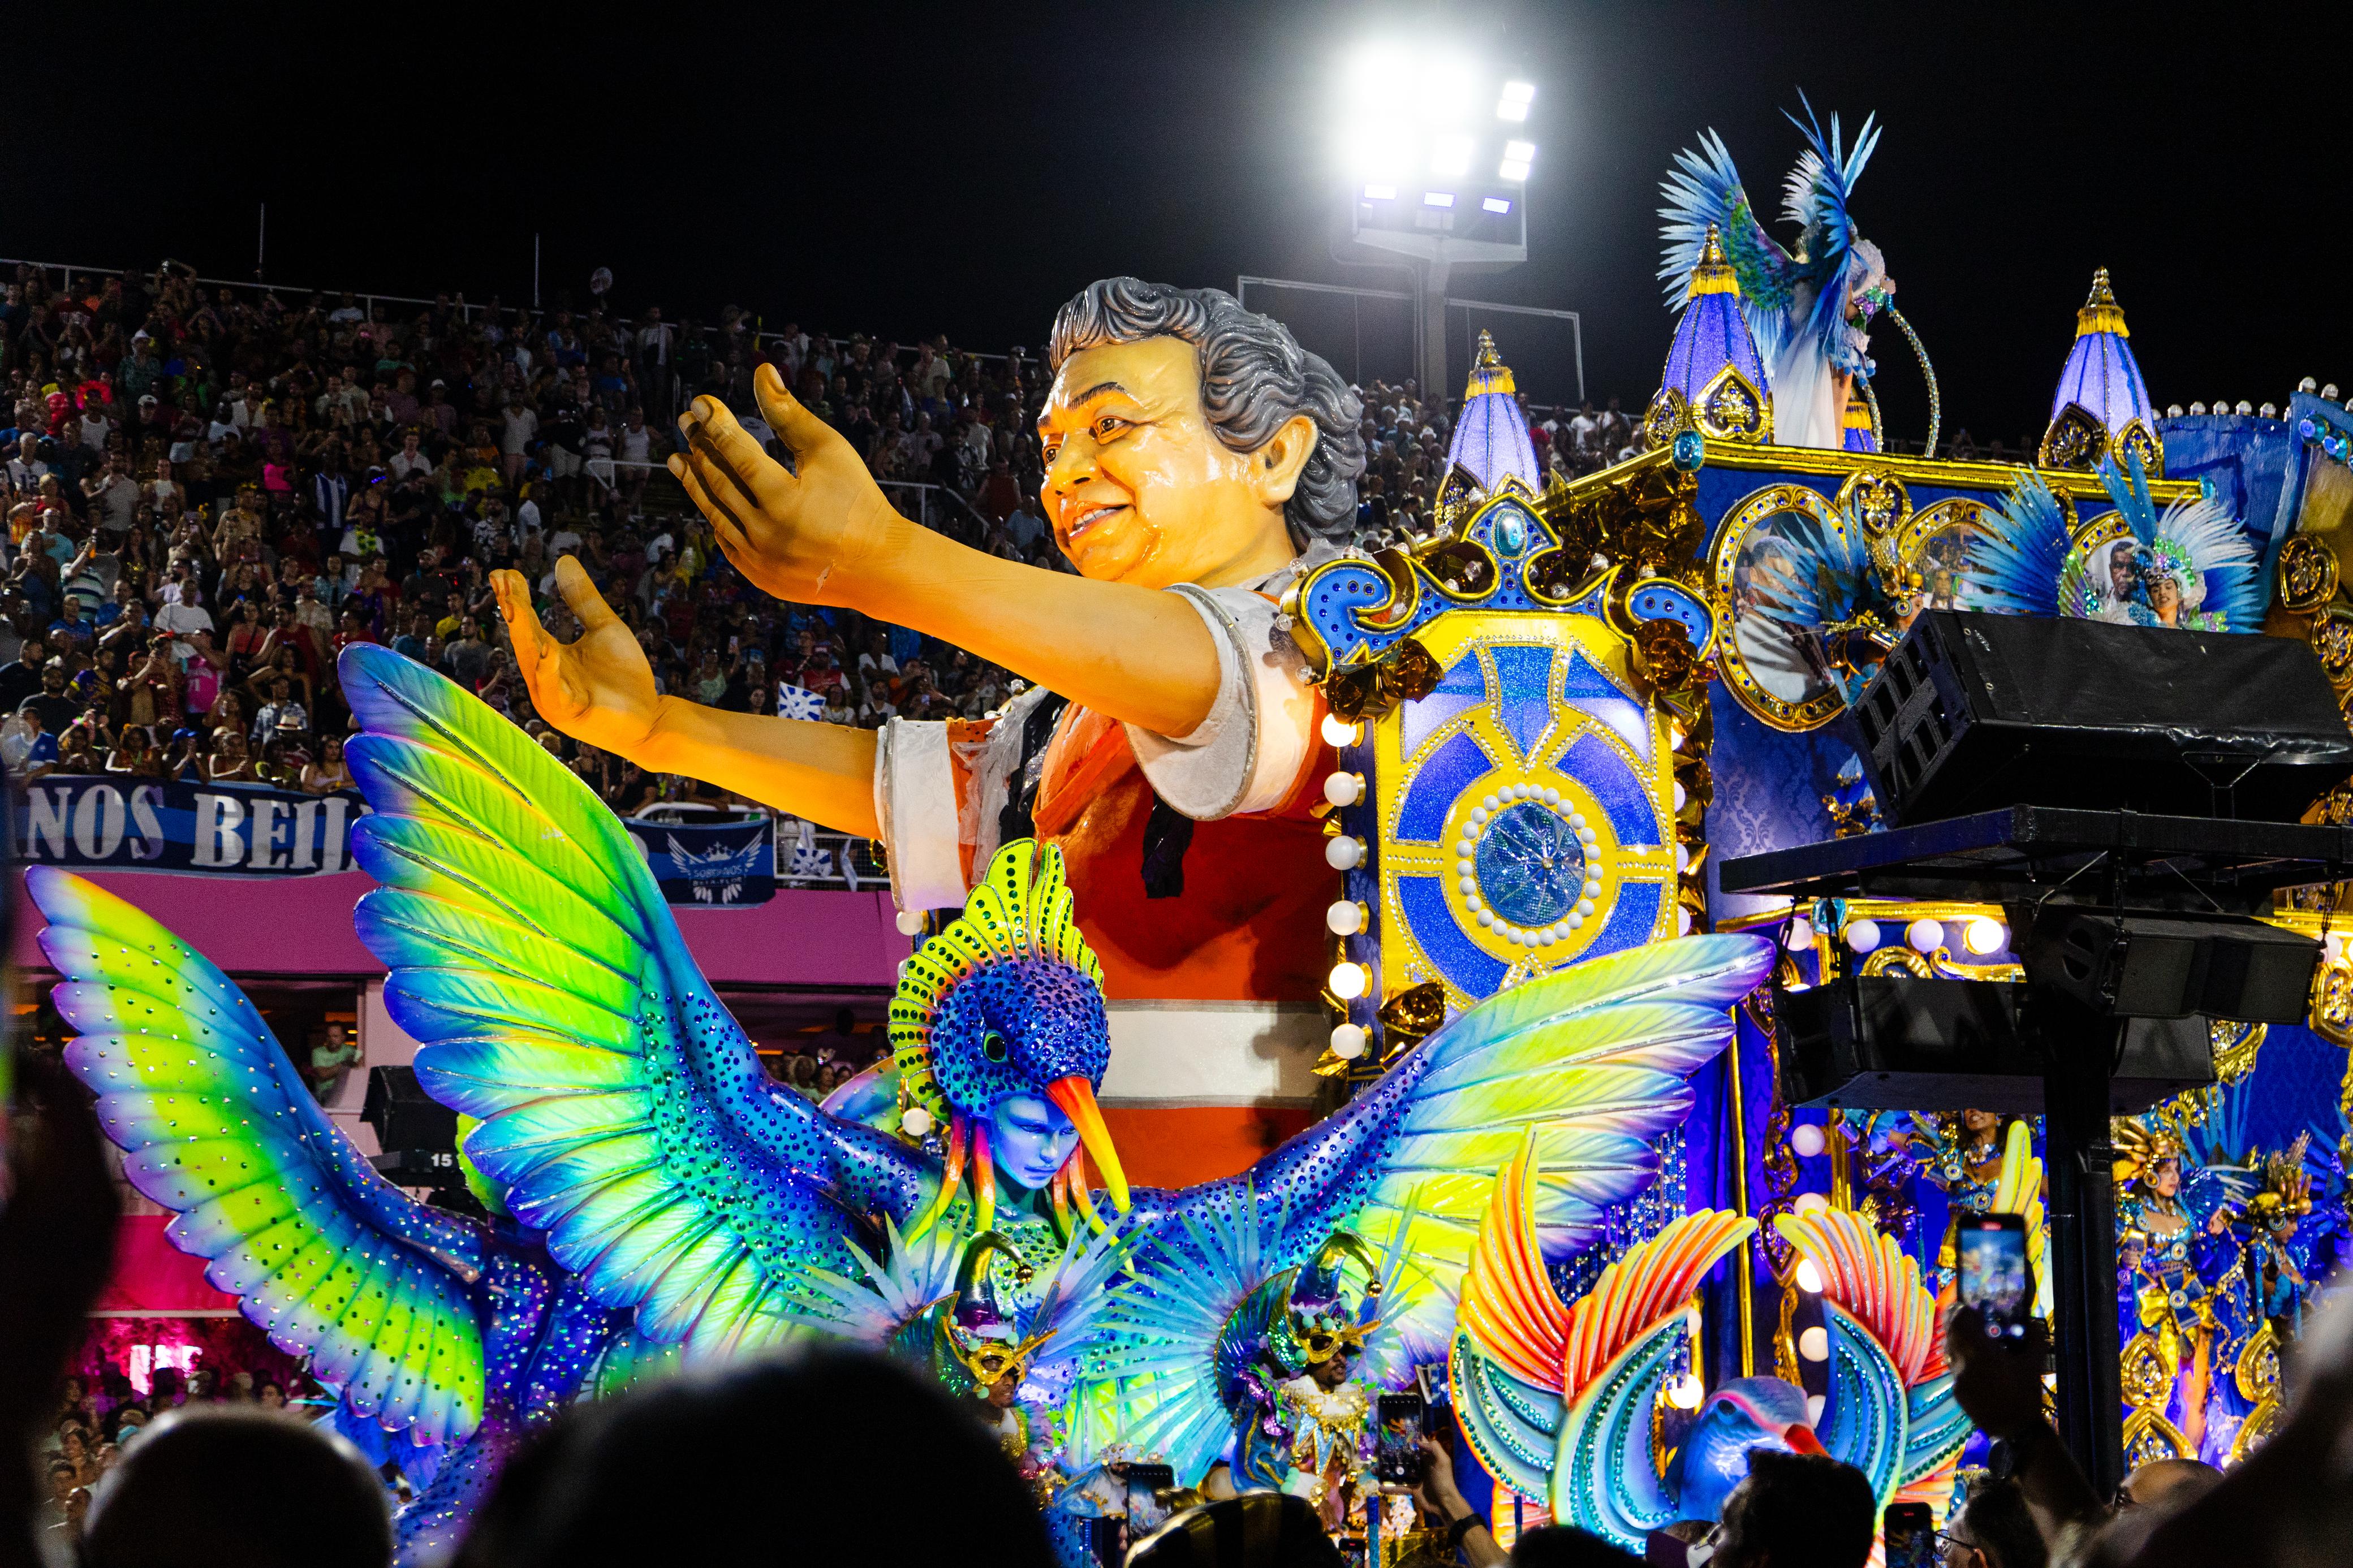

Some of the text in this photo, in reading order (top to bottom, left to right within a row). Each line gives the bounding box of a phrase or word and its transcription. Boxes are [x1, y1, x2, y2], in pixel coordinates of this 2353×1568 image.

[6, 784, 374, 874] NOS BEIJ
[431, 1154, 453, 1167] 15
